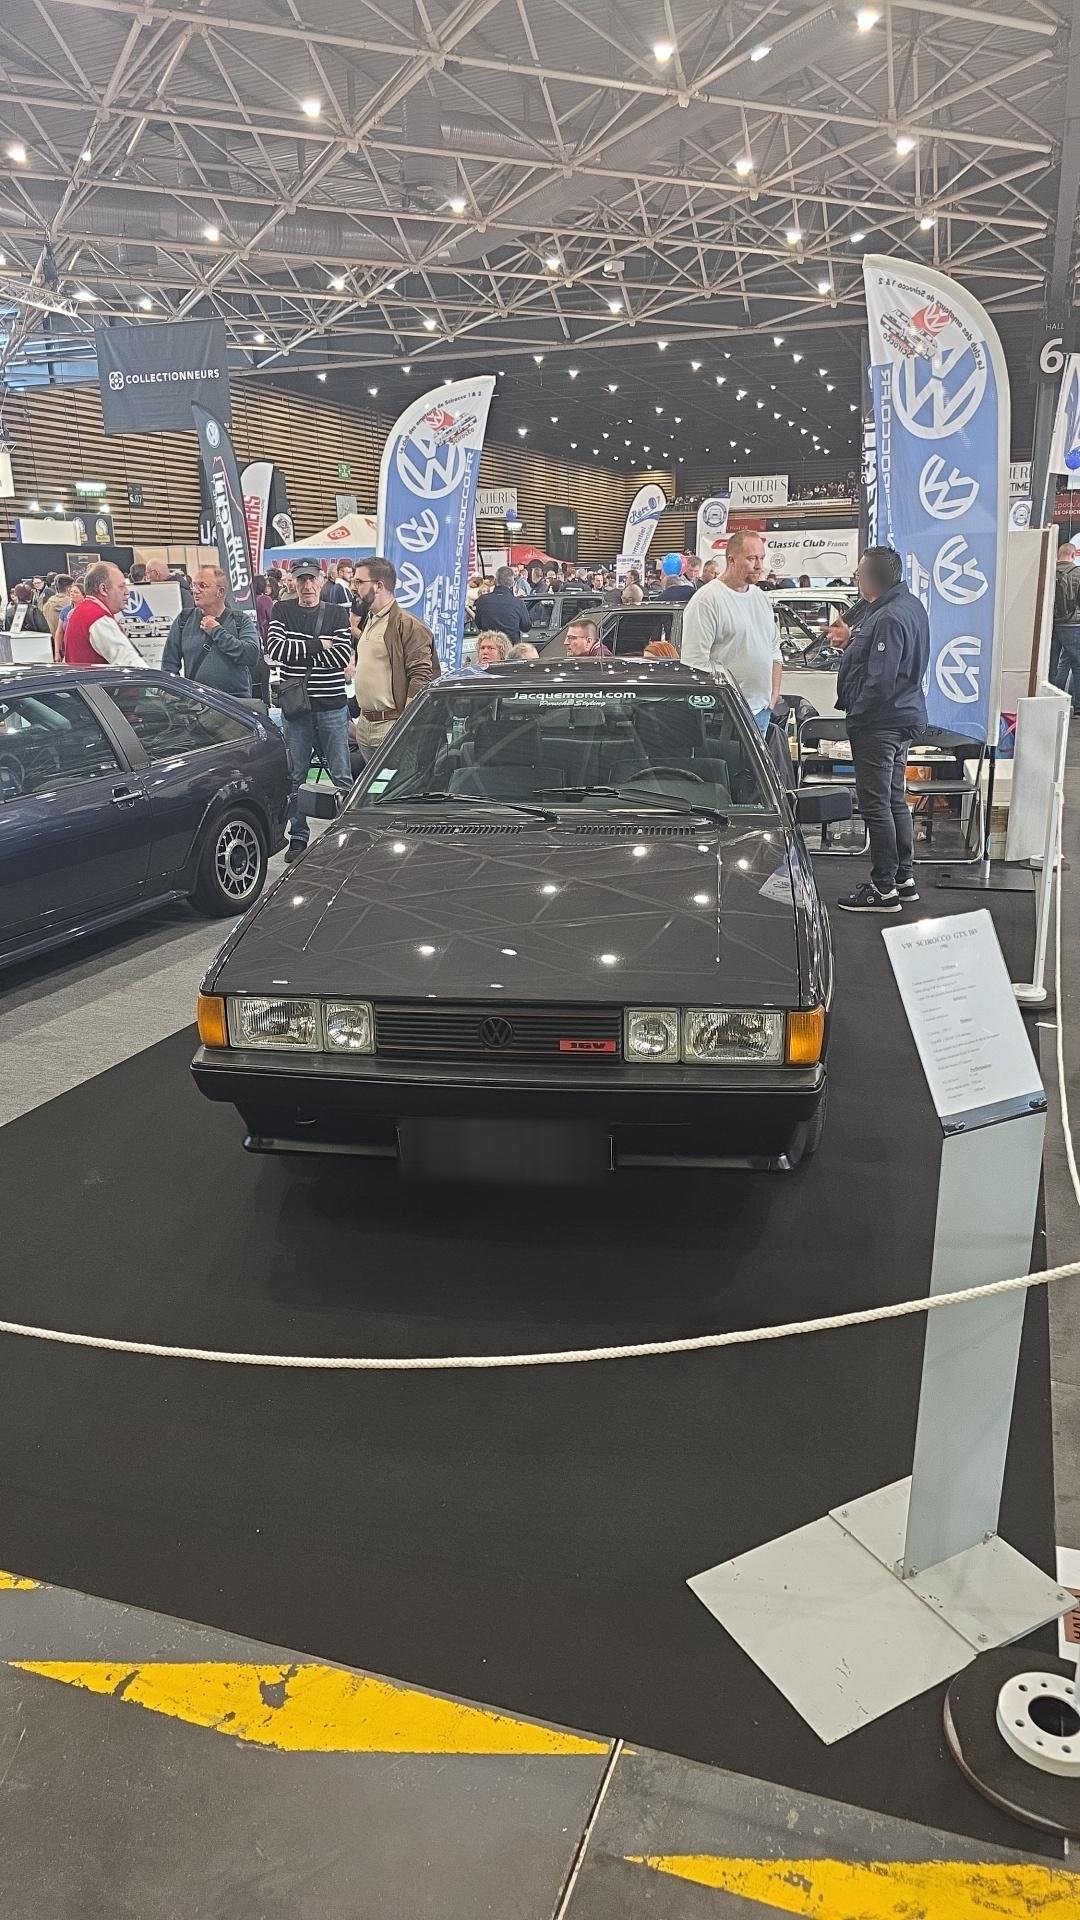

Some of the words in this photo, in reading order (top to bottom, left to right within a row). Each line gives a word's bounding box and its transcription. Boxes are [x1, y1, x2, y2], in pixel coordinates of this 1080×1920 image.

[1045, 322, 1065, 331] HALL
[1040, 338, 1064, 374] 6
[125, 368, 220, 384] COLLECTIONNEURS
[742, 494, 774, 505] MOTOS
[479, 505, 504, 515] AUTOS
[767, 539, 801, 549] Classic
[802, 539, 826, 548] Club
[509, 690, 637, 701] Jacquemond.com
[901, 940, 914, 950] VW
[915, 934, 951, 947] SCIROCCO
[952, 930, 968, 940] GTX
